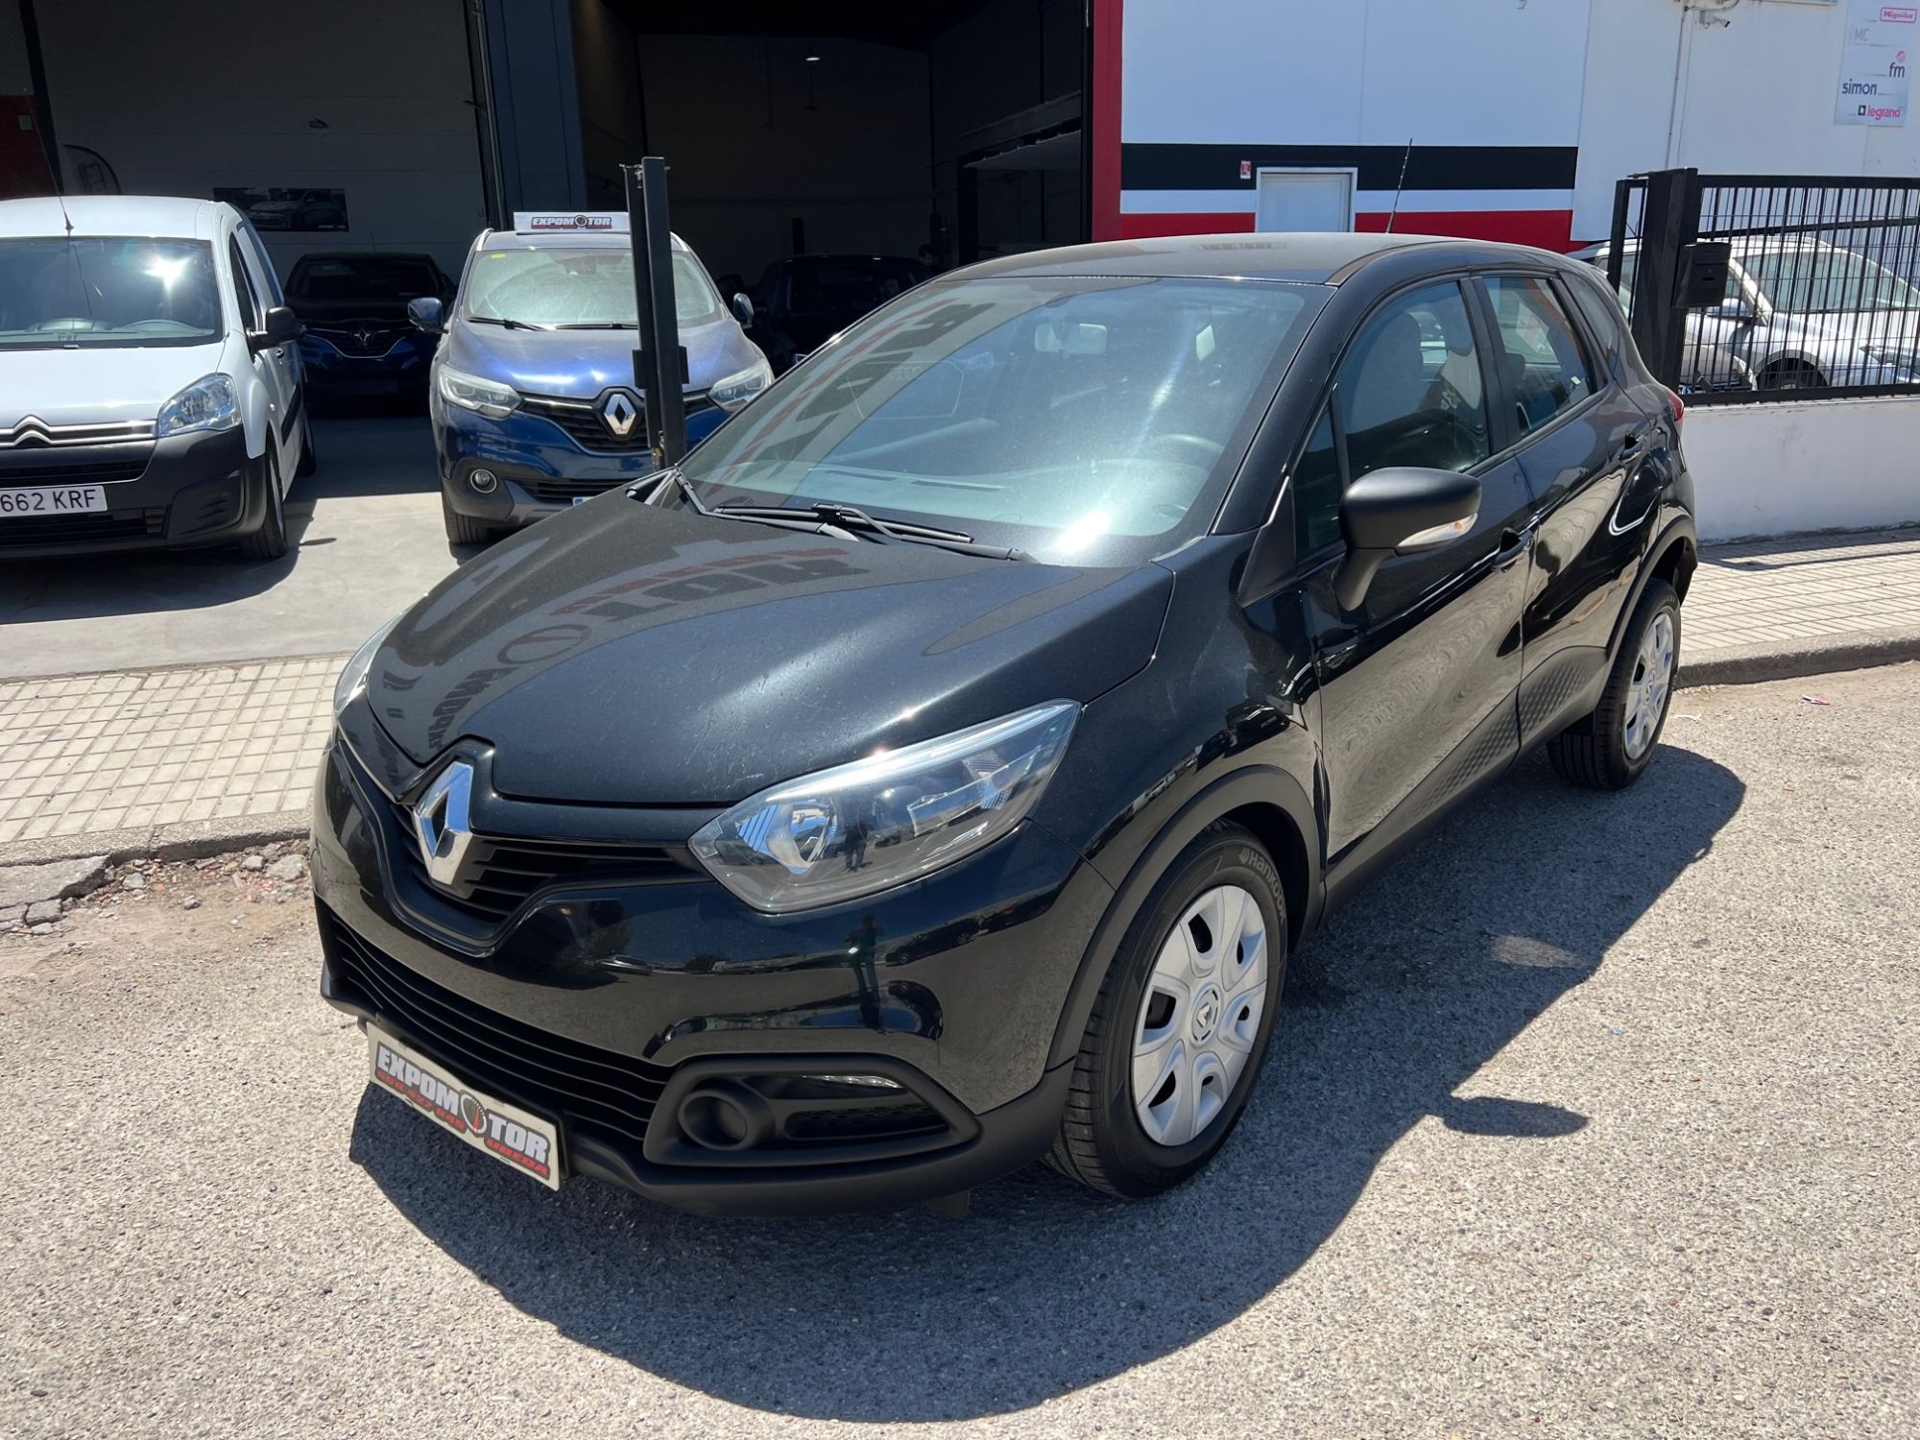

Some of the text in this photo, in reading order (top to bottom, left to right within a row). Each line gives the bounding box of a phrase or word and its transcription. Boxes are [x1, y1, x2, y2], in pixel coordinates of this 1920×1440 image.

[1842, 78, 1878, 95] simon
[1867, 105, 1902, 120] legrand
[0, 489, 96, 512] 662 KRF
[376, 1042, 550, 1164] EXPOMOTOR
